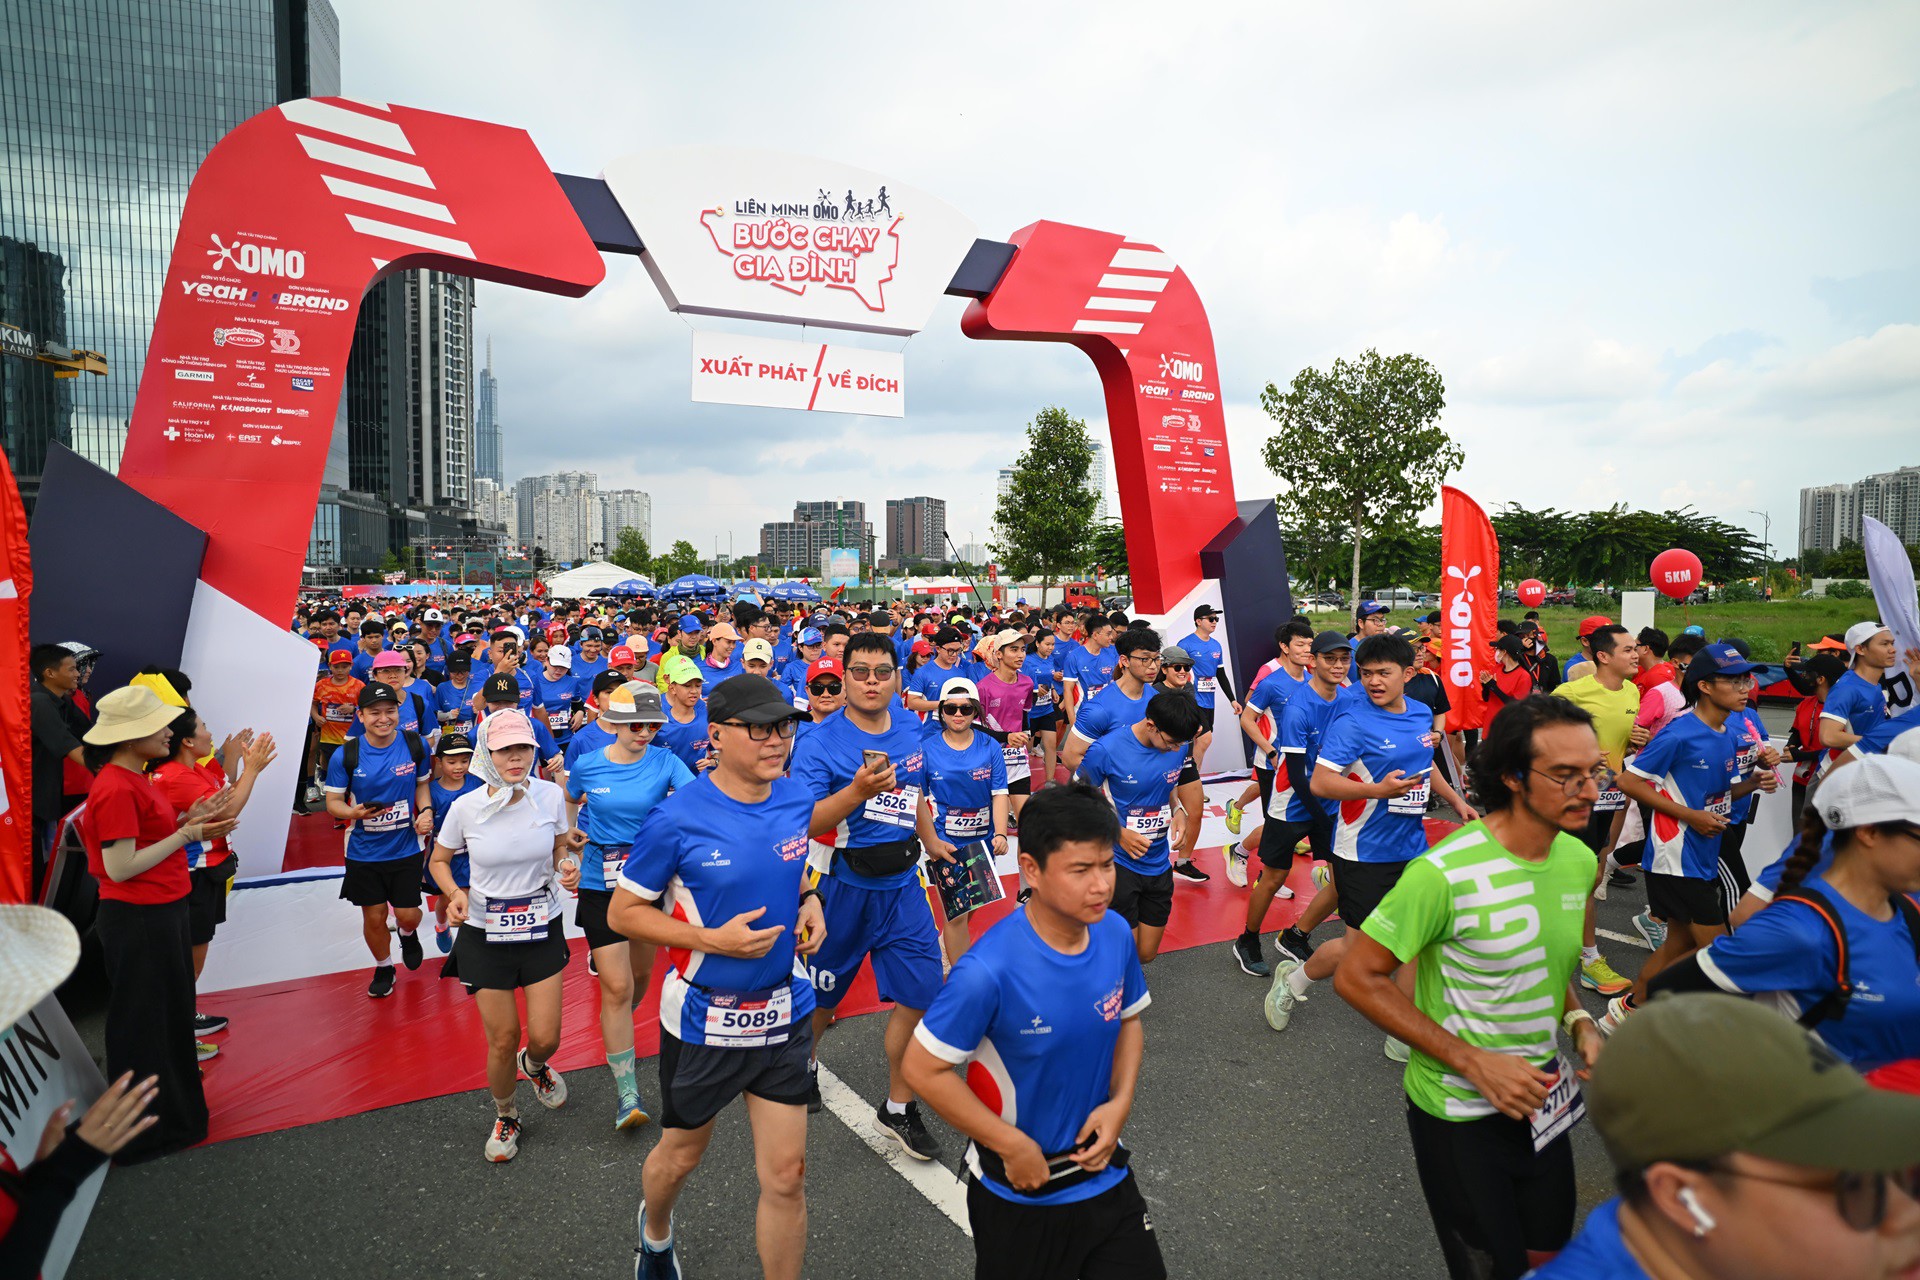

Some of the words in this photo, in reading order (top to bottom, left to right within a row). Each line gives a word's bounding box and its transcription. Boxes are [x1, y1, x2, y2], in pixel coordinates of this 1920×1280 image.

[735, 198, 767, 215] LIÊN
[771, 203, 809, 217] MINH
[813, 204, 839, 220] OMO
[734, 218, 809, 250] BƯỚC
[813, 226, 880, 258] CHẠY
[240, 244, 305, 279] OMO
[733, 254, 785, 282] GIA
[788, 250, 856, 283] ĐÌNH
[0, 326, 32, 347] KIM
[2, 342, 33, 356] LAND
[176, 372, 213, 380] GARMIN
[700, 355, 753, 377] XUẤT
[758, 362, 808, 382] PHÁT
[1173, 359, 1203, 382] OMO
[827, 369, 852, 389] VỀ
[855, 374, 899, 394] ĐÍCH
[172, 400, 216, 408] CALIFORNIA
[1664, 569, 1691, 584] 5KM
[1525, 587, 1541, 596] 5KM
[1450, 600, 1473, 688] OMO
[1002, 748, 1021, 756] 4645
[1736, 755, 1753, 764] 982
[875, 793, 907, 810] 5626
[1600, 792, 1622, 801] 5007
[954, 818, 982, 826] 4722
[1136, 817, 1164, 828] 5975
[500, 912, 536, 926] 5193
[809, 965, 836, 992] 10
[722, 1010, 778, 1028] 5089
[0, 1009, 60, 1138] MIN
[1542, 1077, 1570, 1115] 4717
